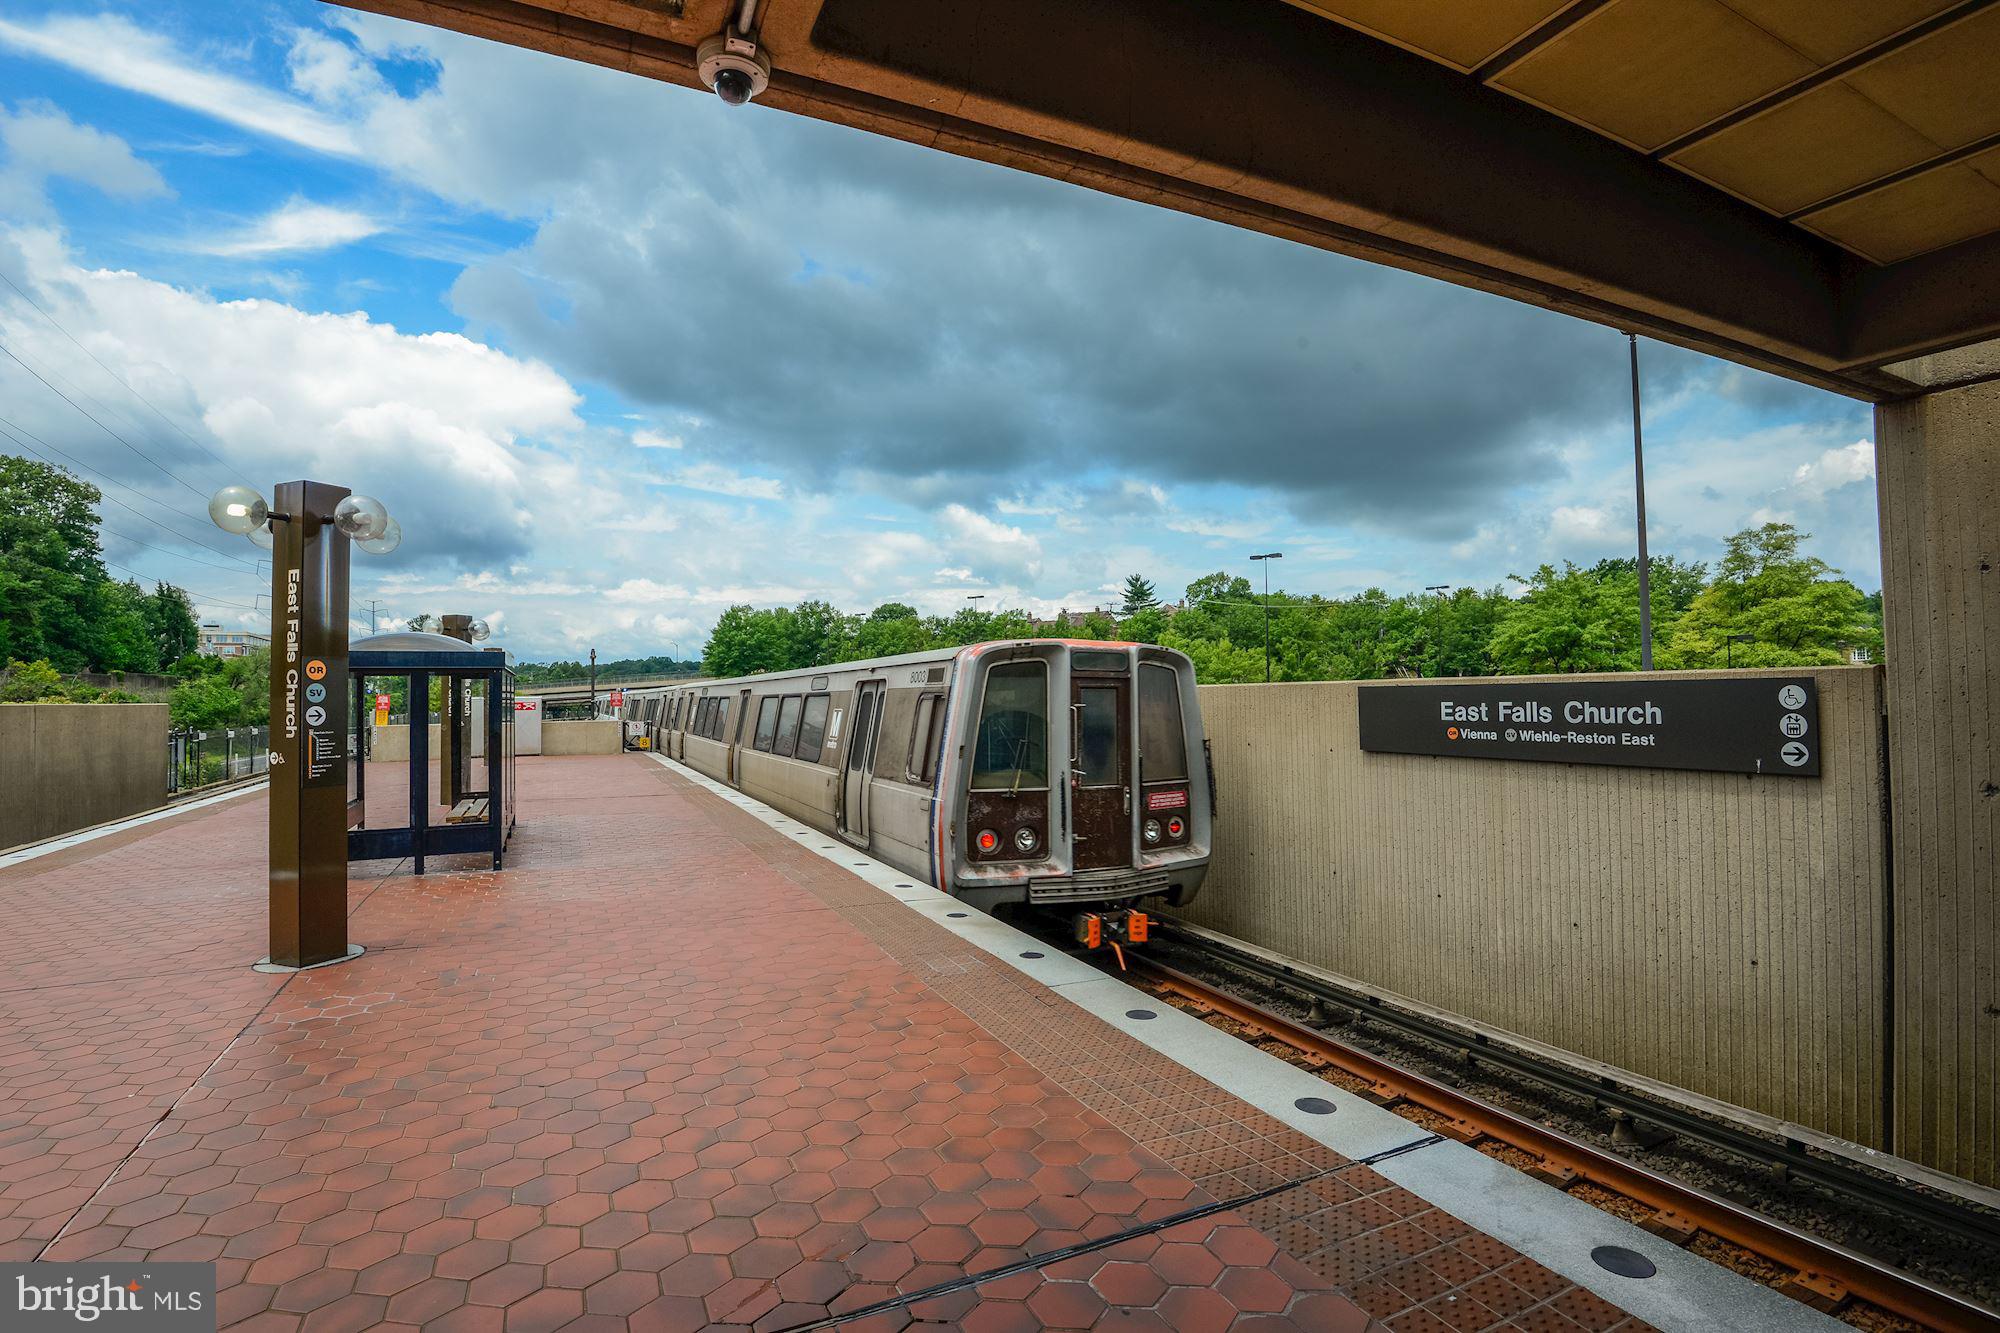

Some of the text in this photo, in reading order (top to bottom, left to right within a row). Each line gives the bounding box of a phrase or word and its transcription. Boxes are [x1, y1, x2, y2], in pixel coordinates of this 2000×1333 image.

[285, 568, 300, 738] East Falls Church
[464, 688, 472, 717] Church
[1440, 700, 1663, 725] East Falls Church
[1460, 728, 1498, 741] Vienna
[1519, 729, 1616, 745] Wiehle-Reston
[1621, 732, 1656, 746] East
